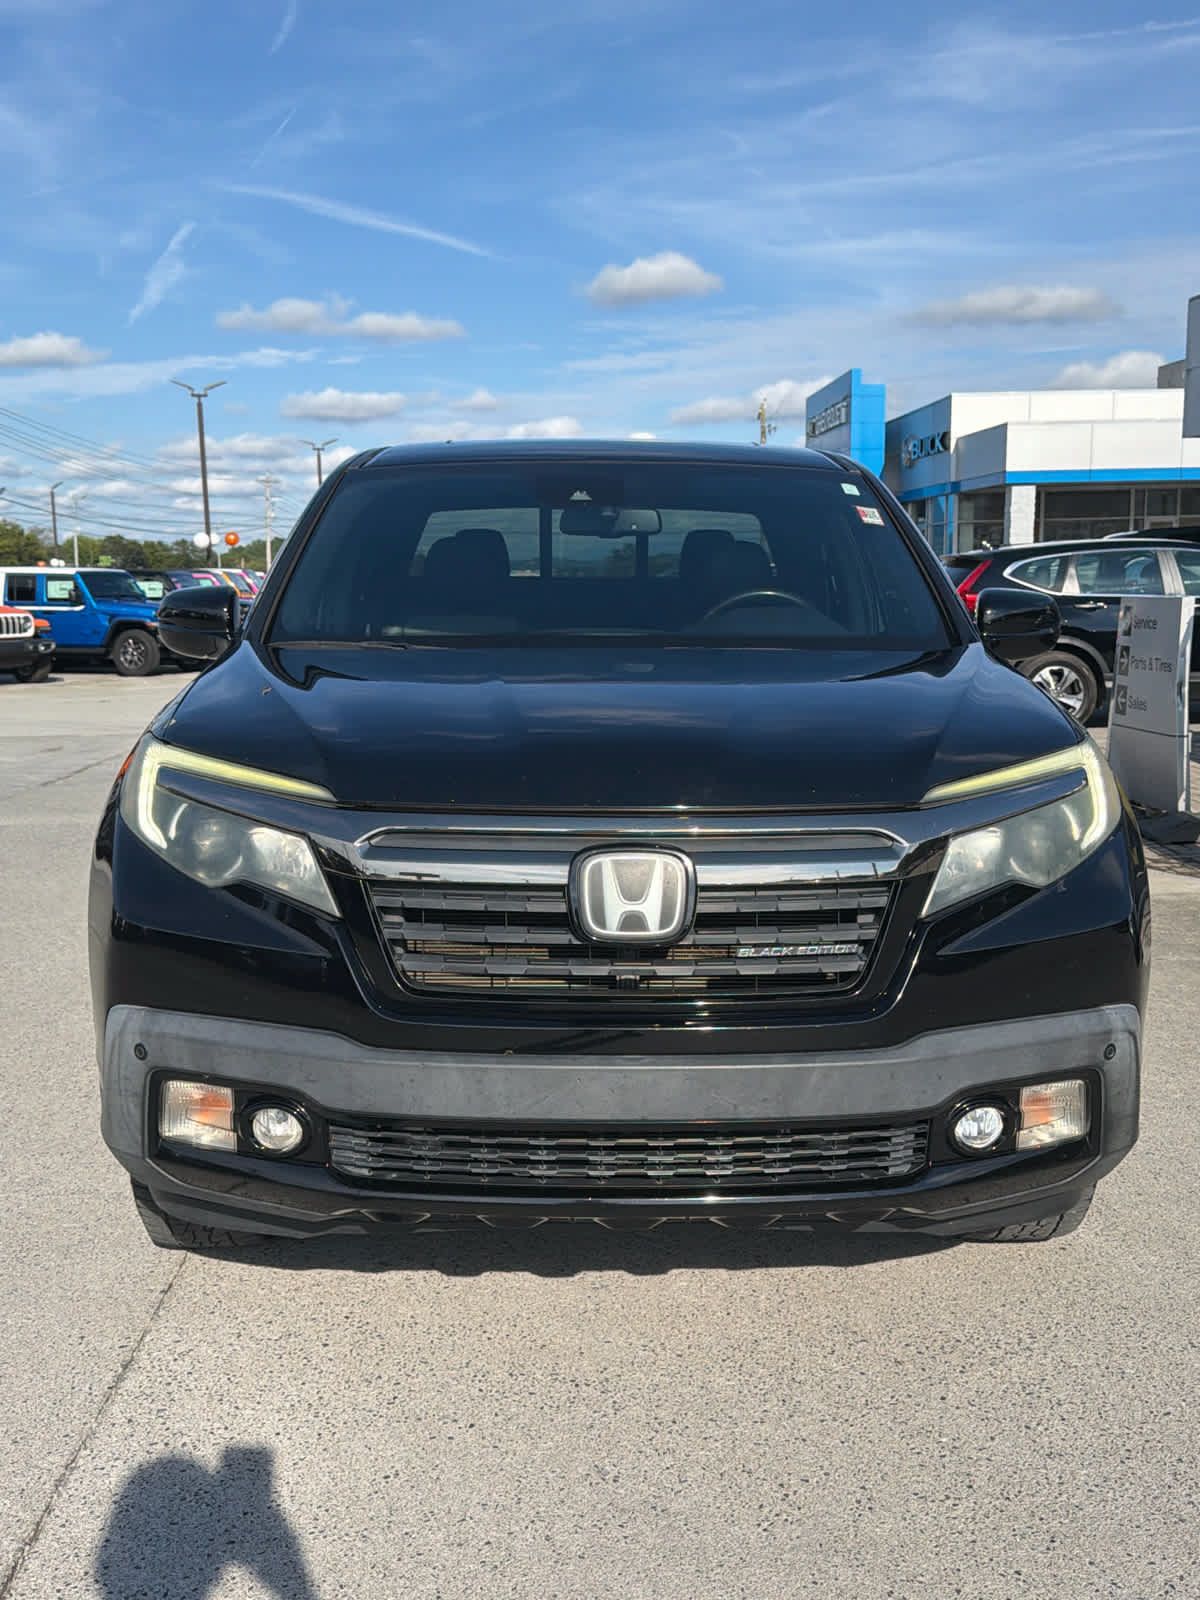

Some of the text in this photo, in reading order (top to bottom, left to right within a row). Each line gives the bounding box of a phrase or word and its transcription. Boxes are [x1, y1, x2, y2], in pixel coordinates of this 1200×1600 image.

[910, 432, 945, 460] BUICK
[1133, 616, 1157, 630] Service
[1130, 656, 1146, 671] Parts
[1155, 657, 1173, 673] Tires
[1127, 696, 1147, 711] Sales
[737, 943, 858, 957] BLACK EDITION
